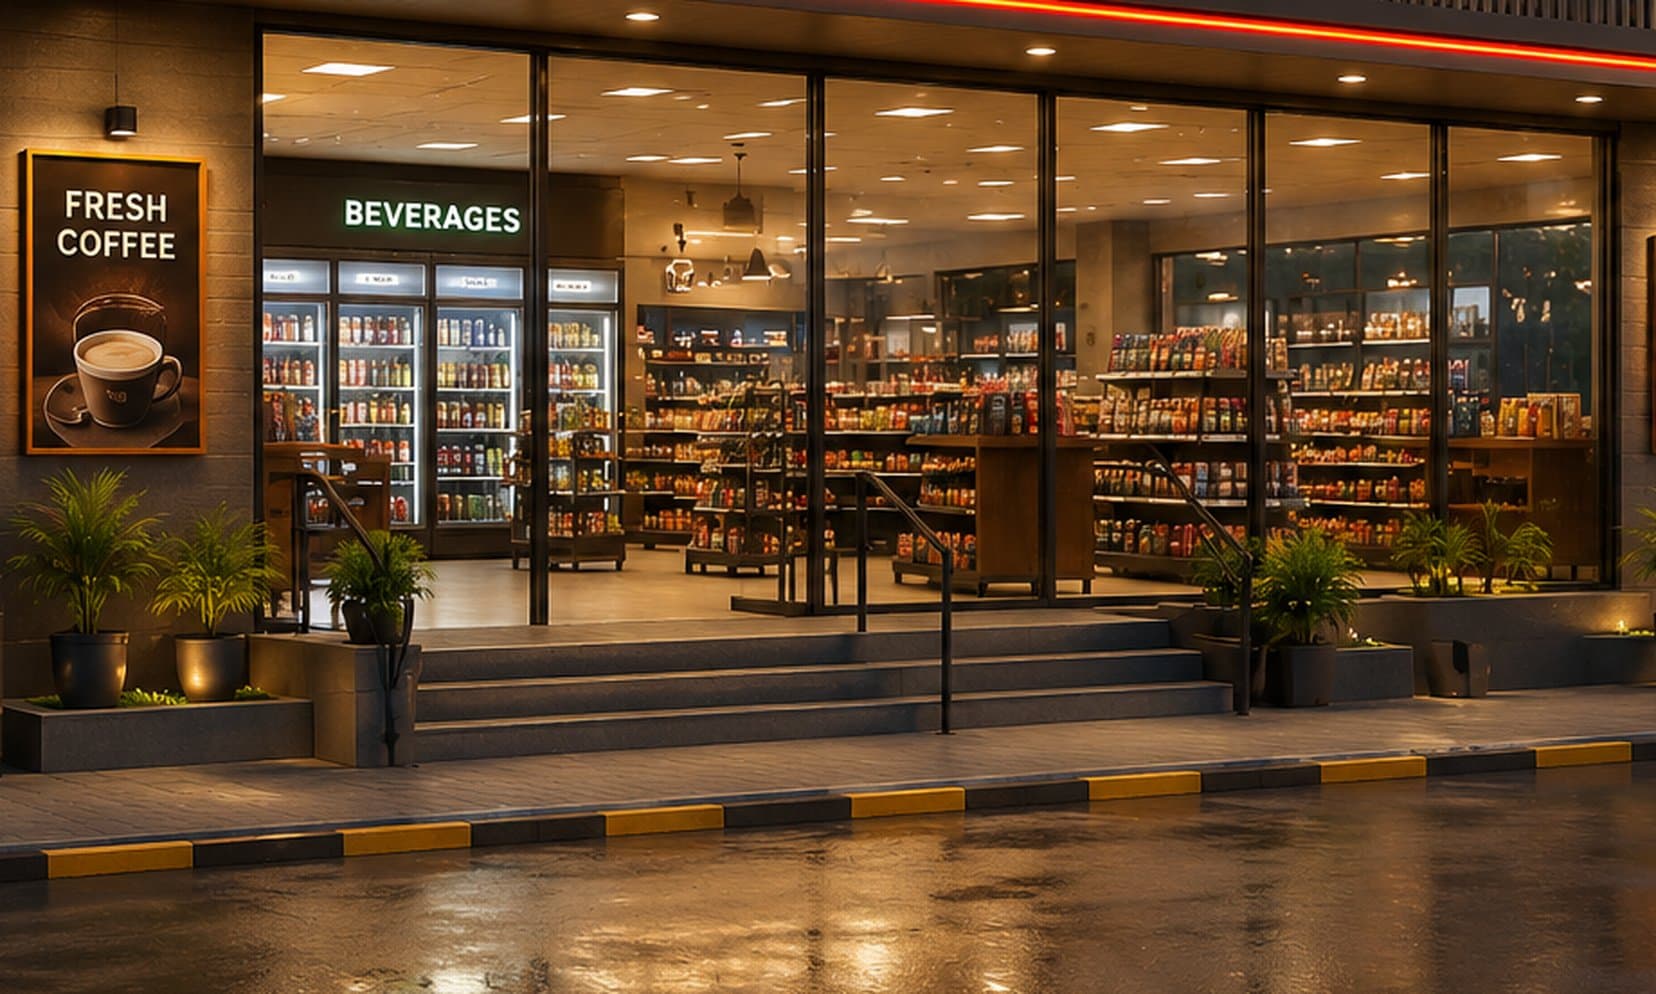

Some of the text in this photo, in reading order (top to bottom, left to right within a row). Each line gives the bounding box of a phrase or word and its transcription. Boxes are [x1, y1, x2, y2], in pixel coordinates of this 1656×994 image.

[65, 190, 168, 223] FRESH
[345, 199, 521, 234] BEVERAGES
[57, 228, 176, 260] COFFEE
